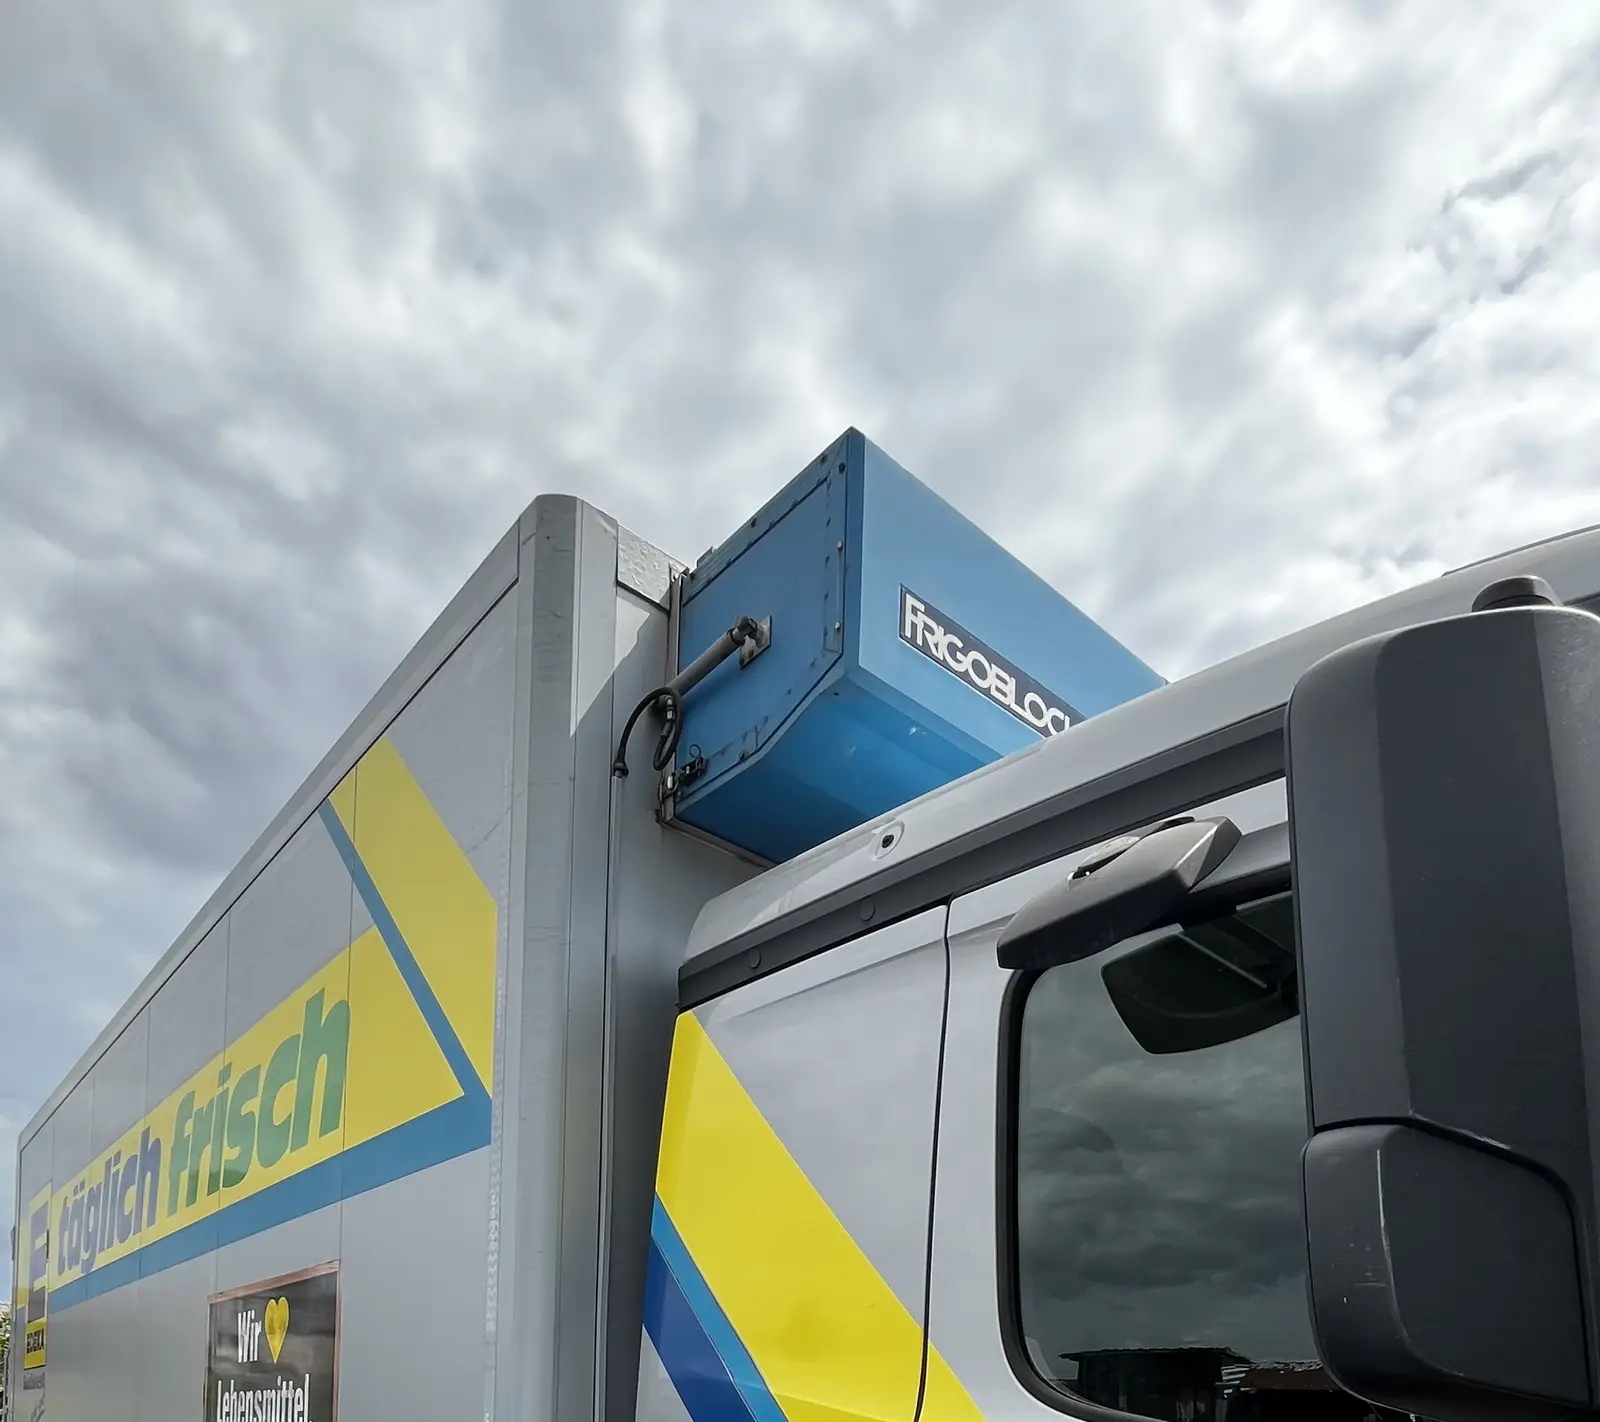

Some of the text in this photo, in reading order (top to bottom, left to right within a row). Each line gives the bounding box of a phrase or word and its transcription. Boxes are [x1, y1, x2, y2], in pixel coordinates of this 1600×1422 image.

[58, 986, 350, 1275] täglich frisch
[237, 1308, 262, 1363] Wir
